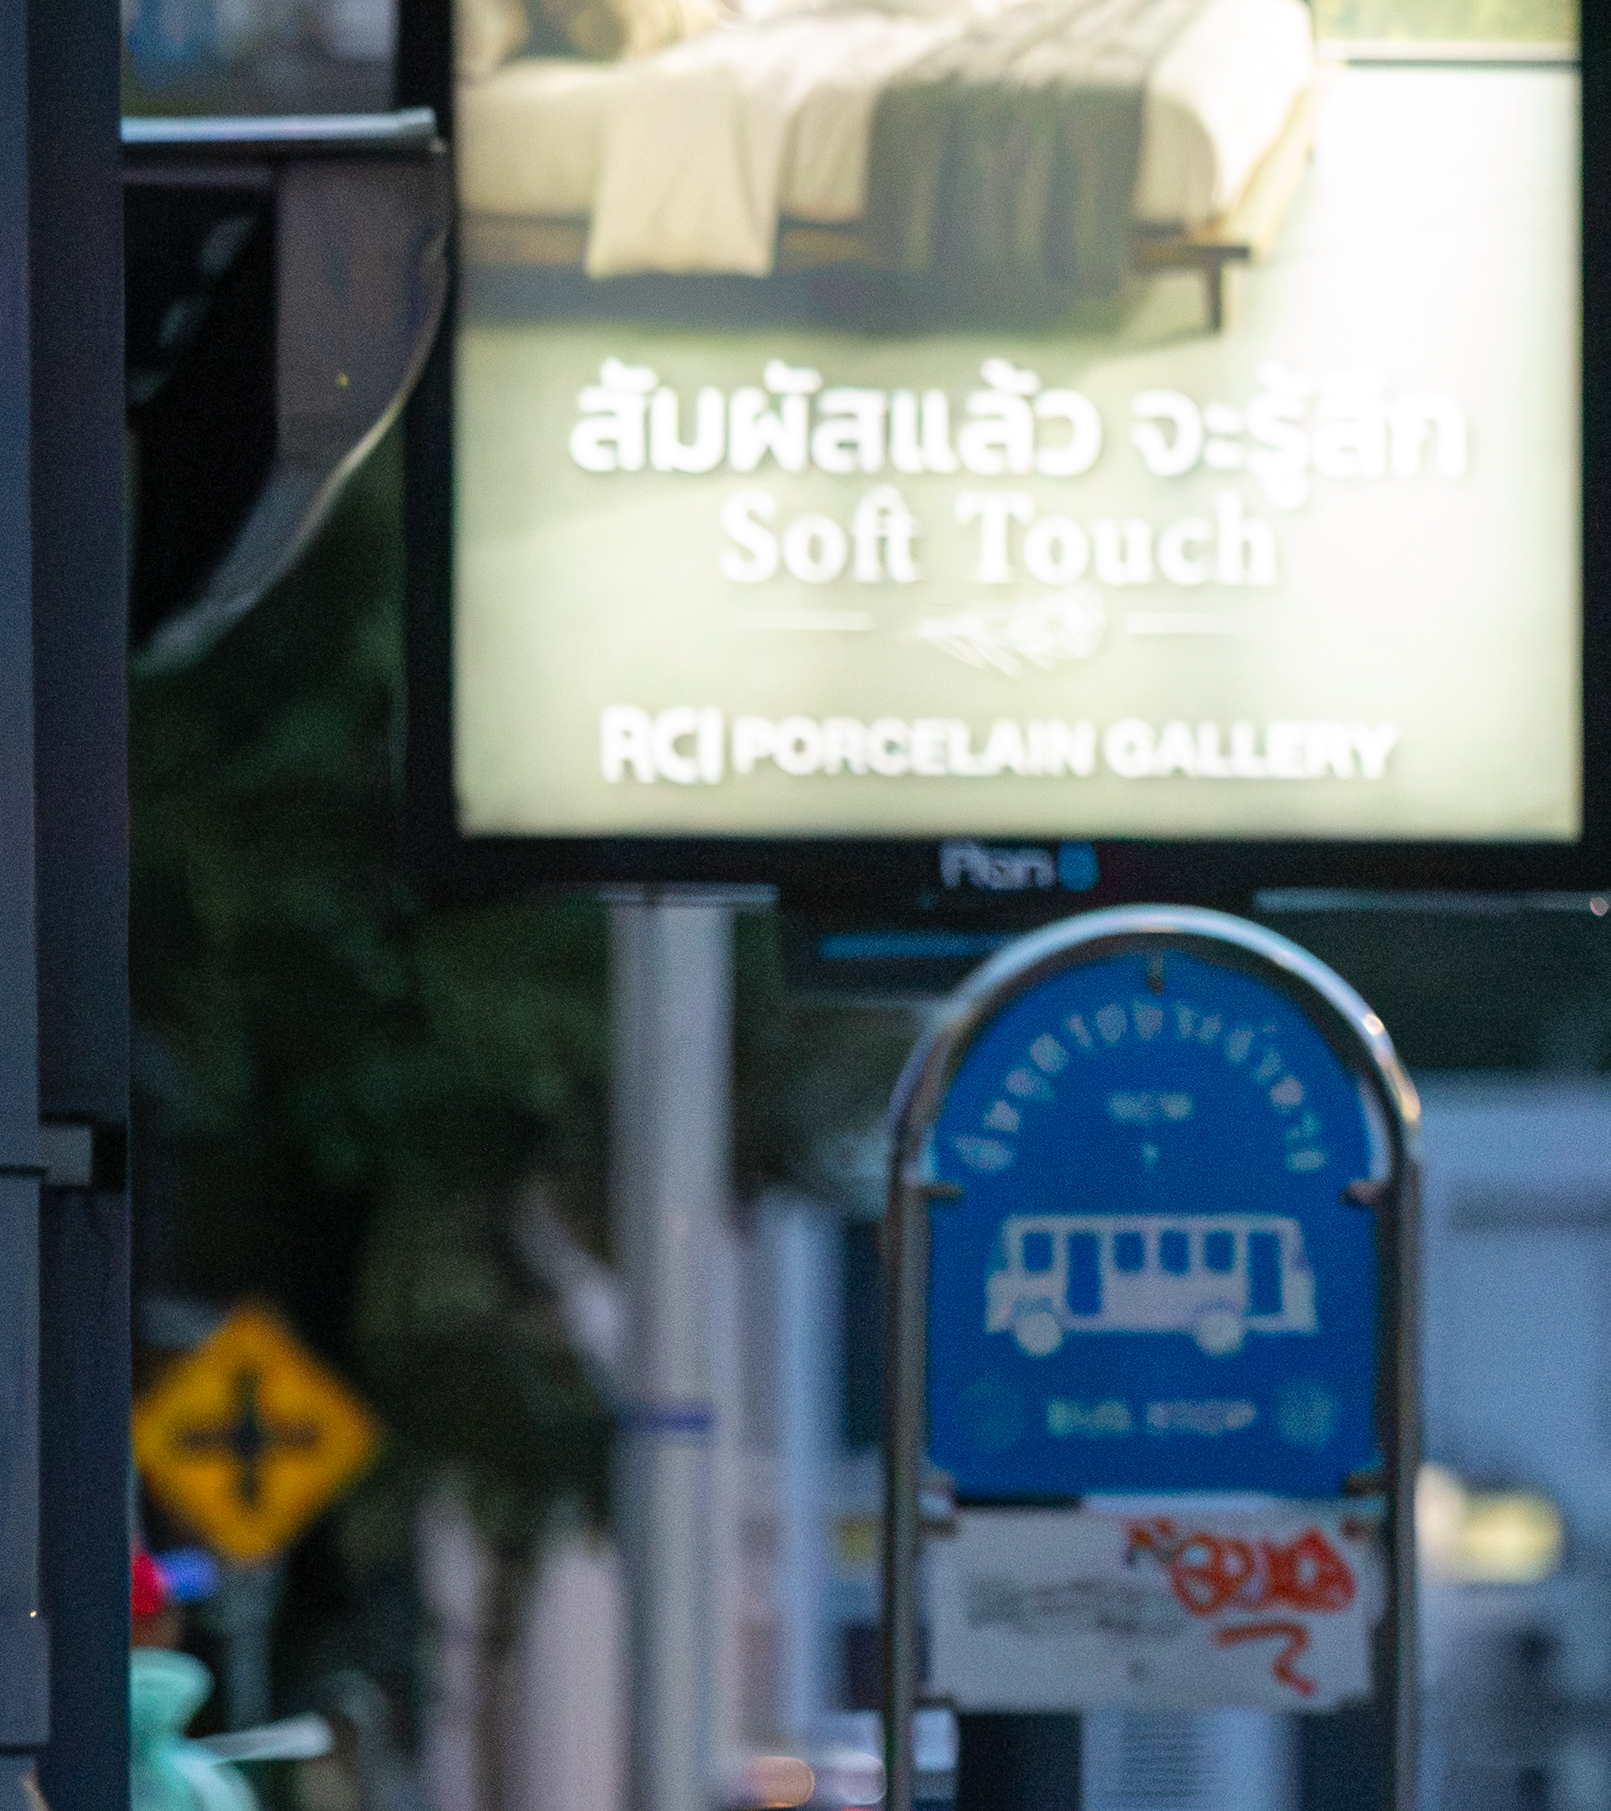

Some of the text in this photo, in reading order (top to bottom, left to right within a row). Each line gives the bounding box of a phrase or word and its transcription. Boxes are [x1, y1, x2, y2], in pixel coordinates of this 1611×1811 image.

[569, 357, 1103, 477] สัมผัสแล้ว
[718, 484, 1279, 588] Soft Touch
[730, 715, 1098, 779] PORCELAIN
[1103, 715, 1400, 779] GALLERY
